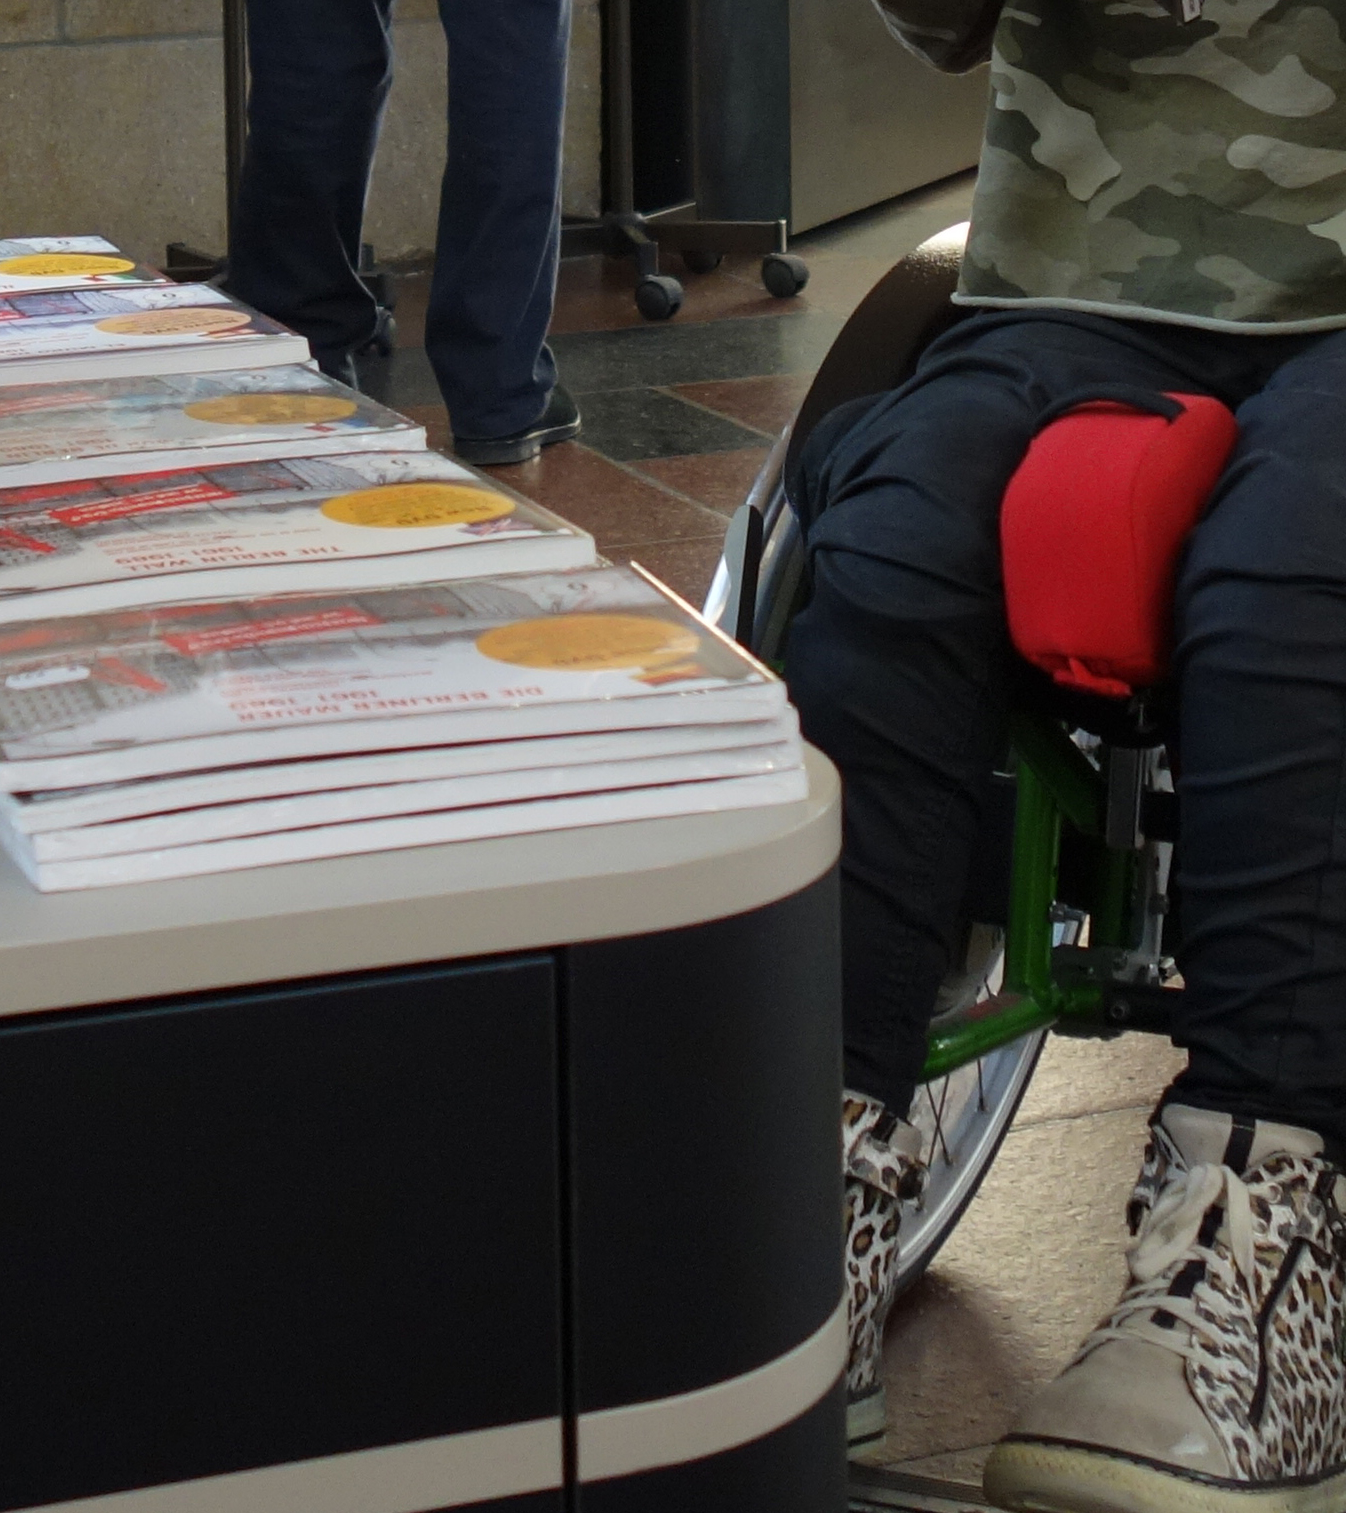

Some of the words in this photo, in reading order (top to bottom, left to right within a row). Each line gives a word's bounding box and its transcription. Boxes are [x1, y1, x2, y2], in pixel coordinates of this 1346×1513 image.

[200, 549, 288, 564] BERLIN
[296, 544, 344, 556] THE
[126, 558, 192, 572] WALL
[498, 686, 545, 699] DIE
[352, 690, 489, 712] BERLINER
[238, 703, 341, 723] MAUER
